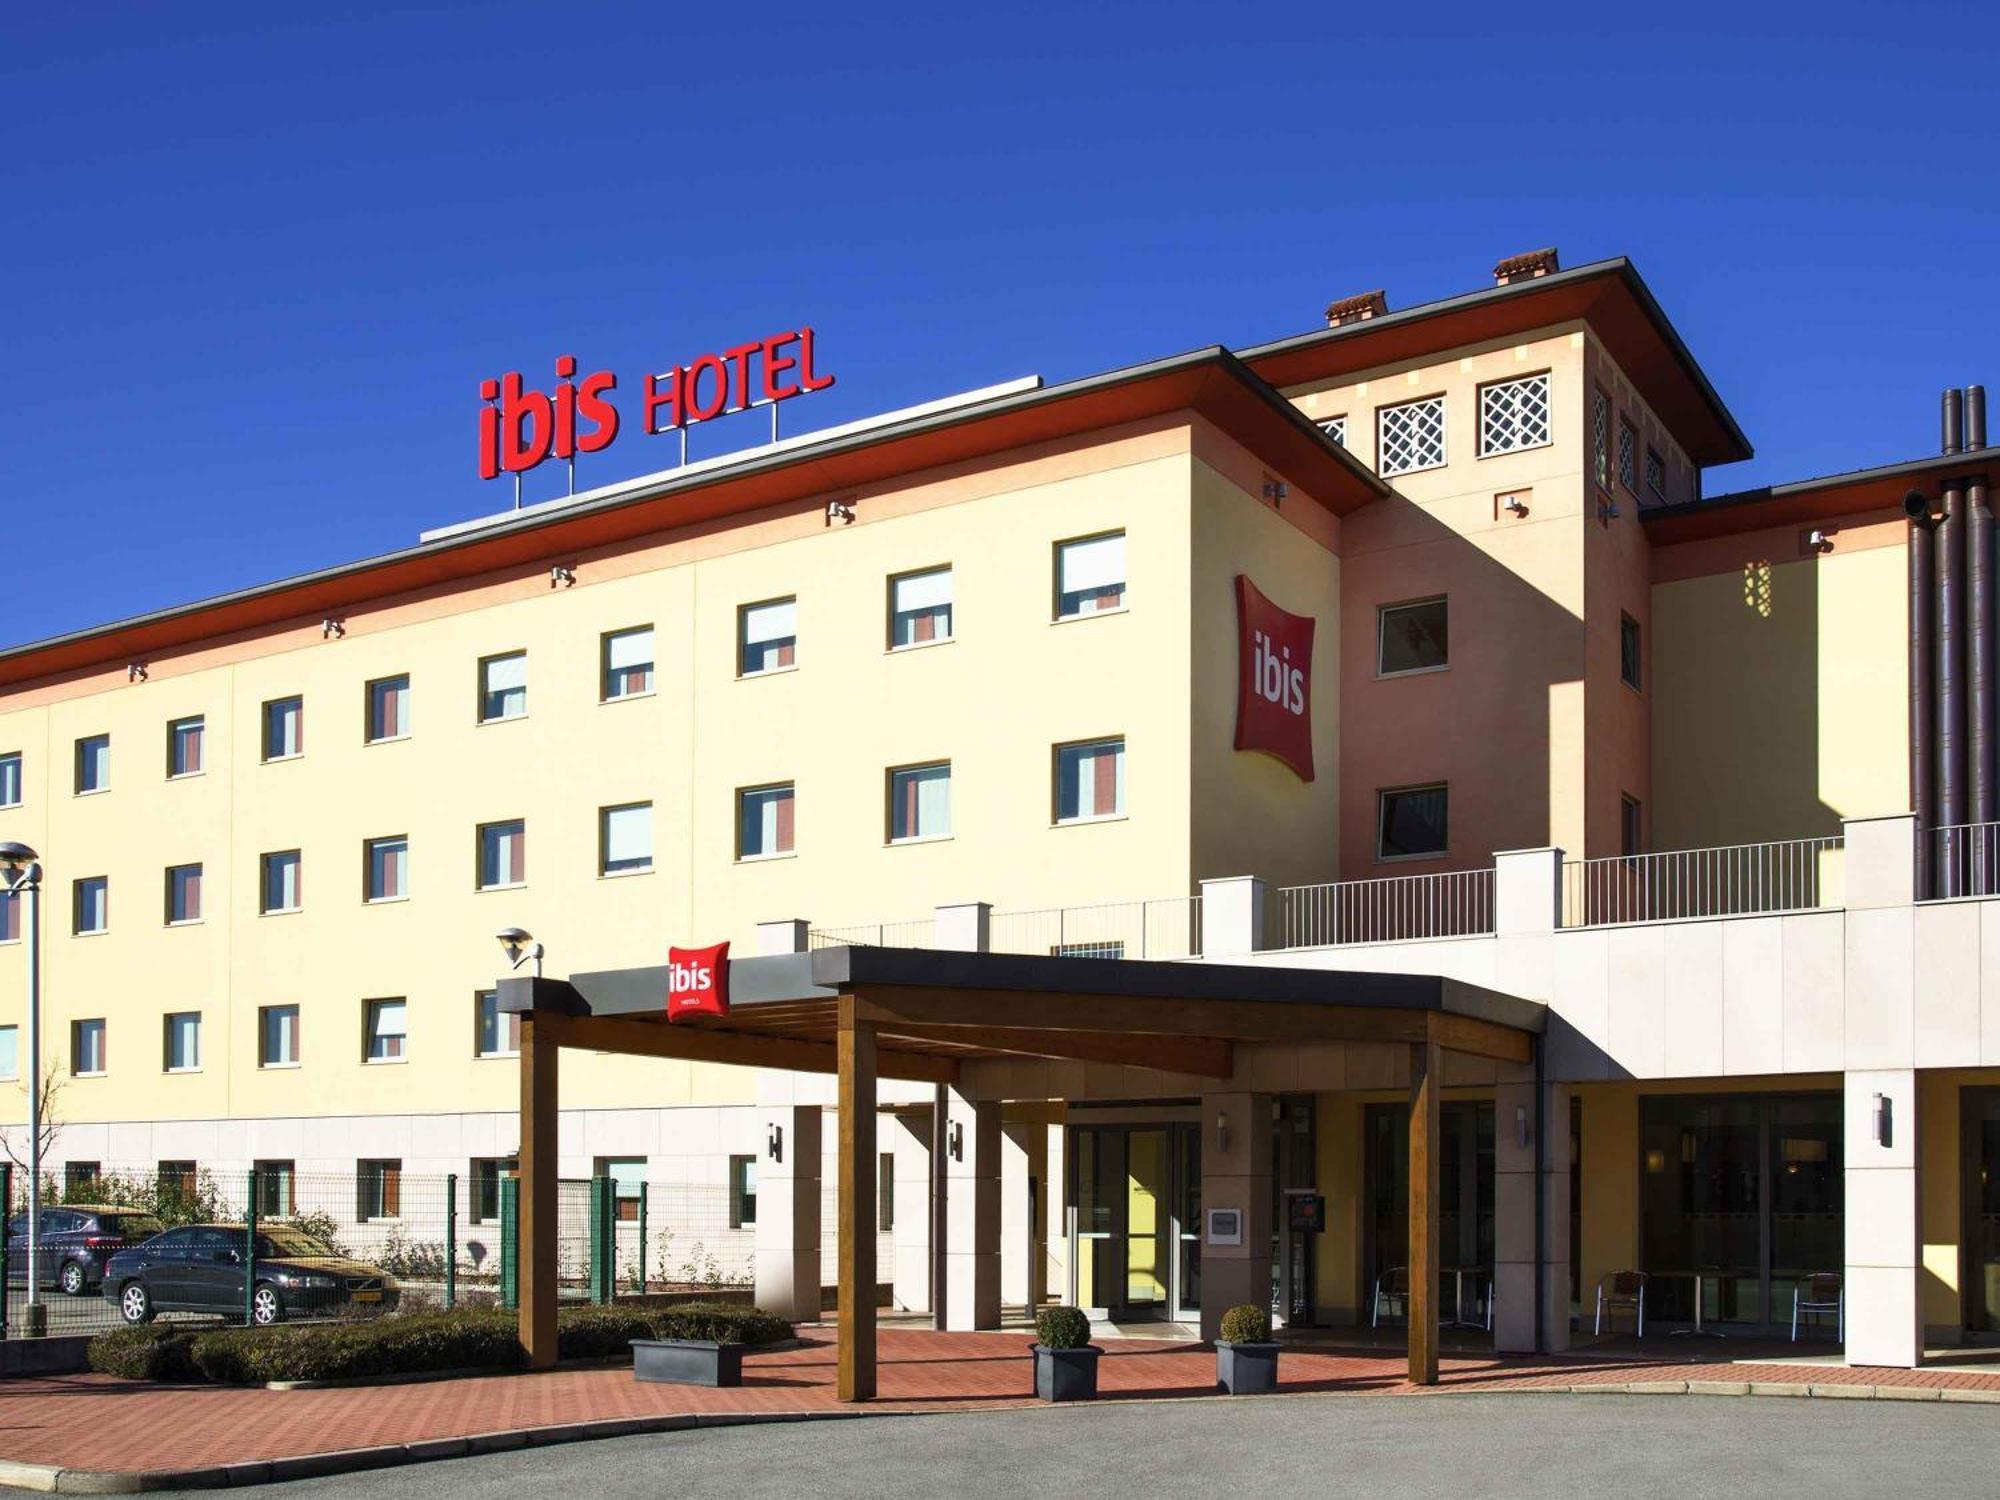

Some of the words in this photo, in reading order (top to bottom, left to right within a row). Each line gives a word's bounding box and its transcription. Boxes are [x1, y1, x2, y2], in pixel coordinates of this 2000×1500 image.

[479, 355, 618, 479] ibis
[643, 326, 834, 433] HOTEL
[1255, 629, 1304, 715] ibis
[669, 960, 711, 993] ibis
